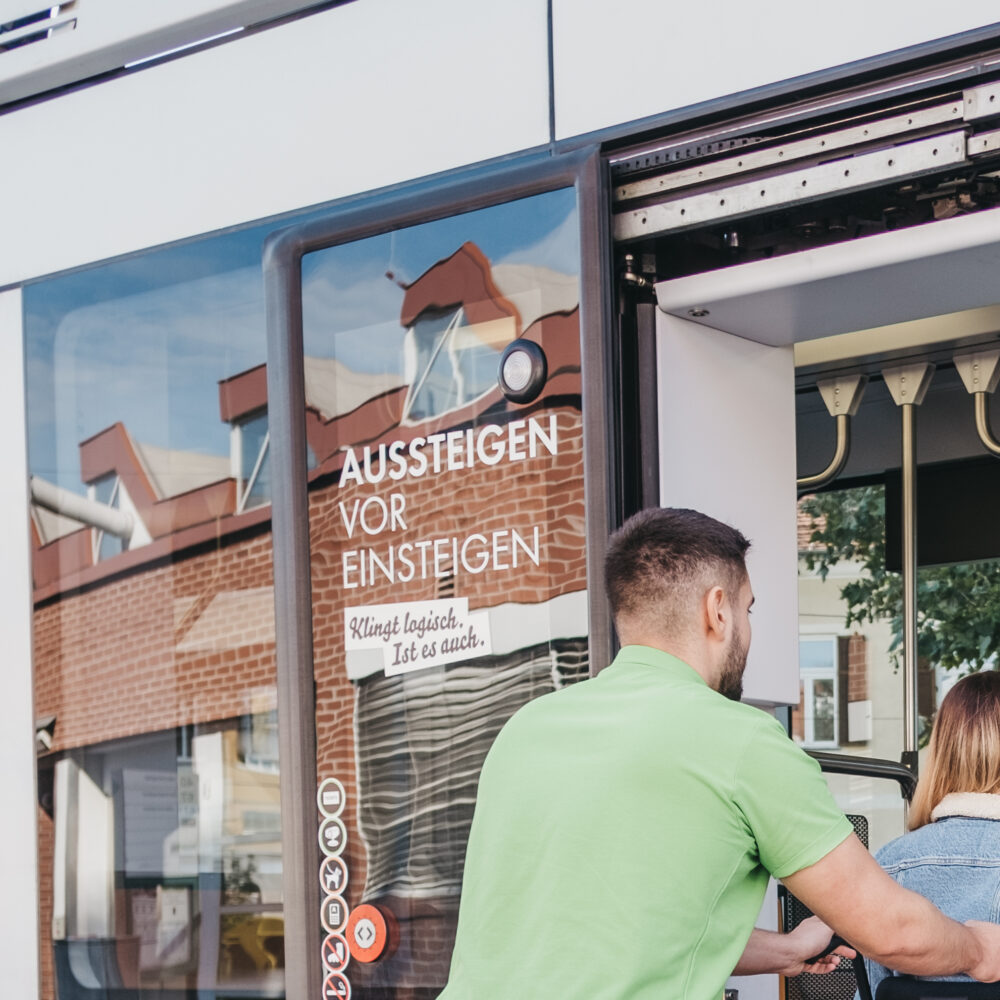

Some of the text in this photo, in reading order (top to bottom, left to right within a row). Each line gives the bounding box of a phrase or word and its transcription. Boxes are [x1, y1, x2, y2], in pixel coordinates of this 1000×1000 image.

[338, 415, 558, 488] AUSSTEIGEN
[339, 493, 407, 539] VOR
[342, 526, 540, 589] EINSTEIGEN
[350, 607, 464, 642] Klingt logisch.
[391, 625, 485, 666] Ist es auch.
